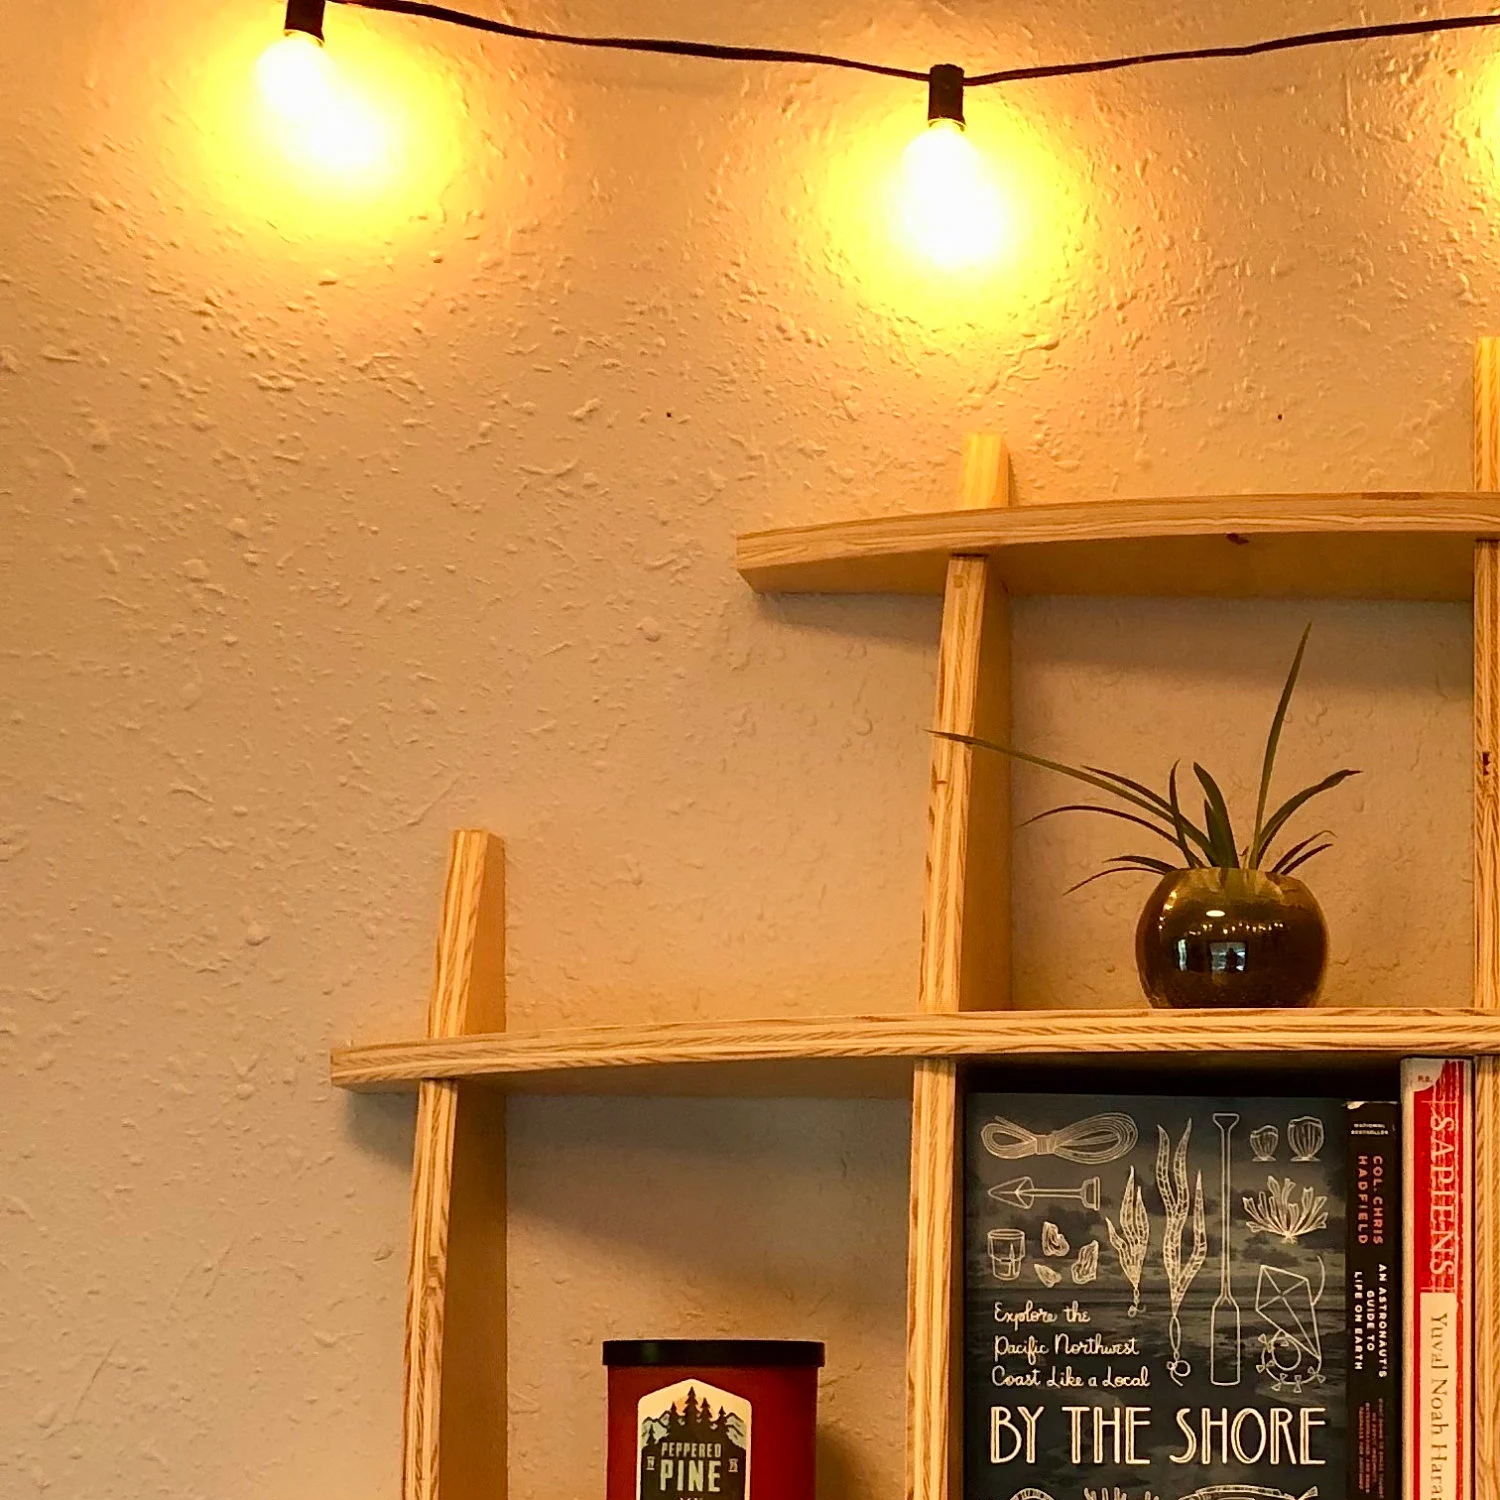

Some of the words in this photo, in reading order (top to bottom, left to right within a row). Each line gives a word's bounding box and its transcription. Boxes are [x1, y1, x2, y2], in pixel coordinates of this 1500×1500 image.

[1373, 1155, 1384, 1192] COL.
[1358, 1155, 1368, 1244] HADFIELD
[1430, 1116, 1456, 1276] SAPIENS
[1373, 1196, 1384, 1245] CHRIS
[1354, 1271, 1363, 1299] LIFE
[1378, 1263, 1388, 1282] AN
[993, 1299, 1058, 1331] Explore
[1063, 1300, 1091, 1323] the
[1354, 1304, 1363, 1323] ON
[1366, 1290, 1376, 1330] GUIDE
[993, 1335, 1050, 1366] Pacific
[1054, 1333, 1140, 1355] Northwest
[1354, 1327, 1364, 1371] EARTH
[1366, 1334, 1376, 1352] TO
[1378, 1286, 1388, 1378] ASTRONAUT'S
[1430, 1312, 1449, 1370] Yuval
[991, 1364, 1042, 1387] Coast
[1046, 1365, 1085, 1389] Like
[1088, 1376, 1099, 1387] a
[1101, 1365, 1151, 1388] Local
[1430, 1378, 1449, 1437] Noah
[661, 1442, 722, 1459] PEPPERED
[990, 1405, 1046, 1464] BY
[1061, 1406, 1152, 1465] THE
[1168, 1407, 1327, 1465] SHORE
[659, 1459, 722, 1493] PINE
